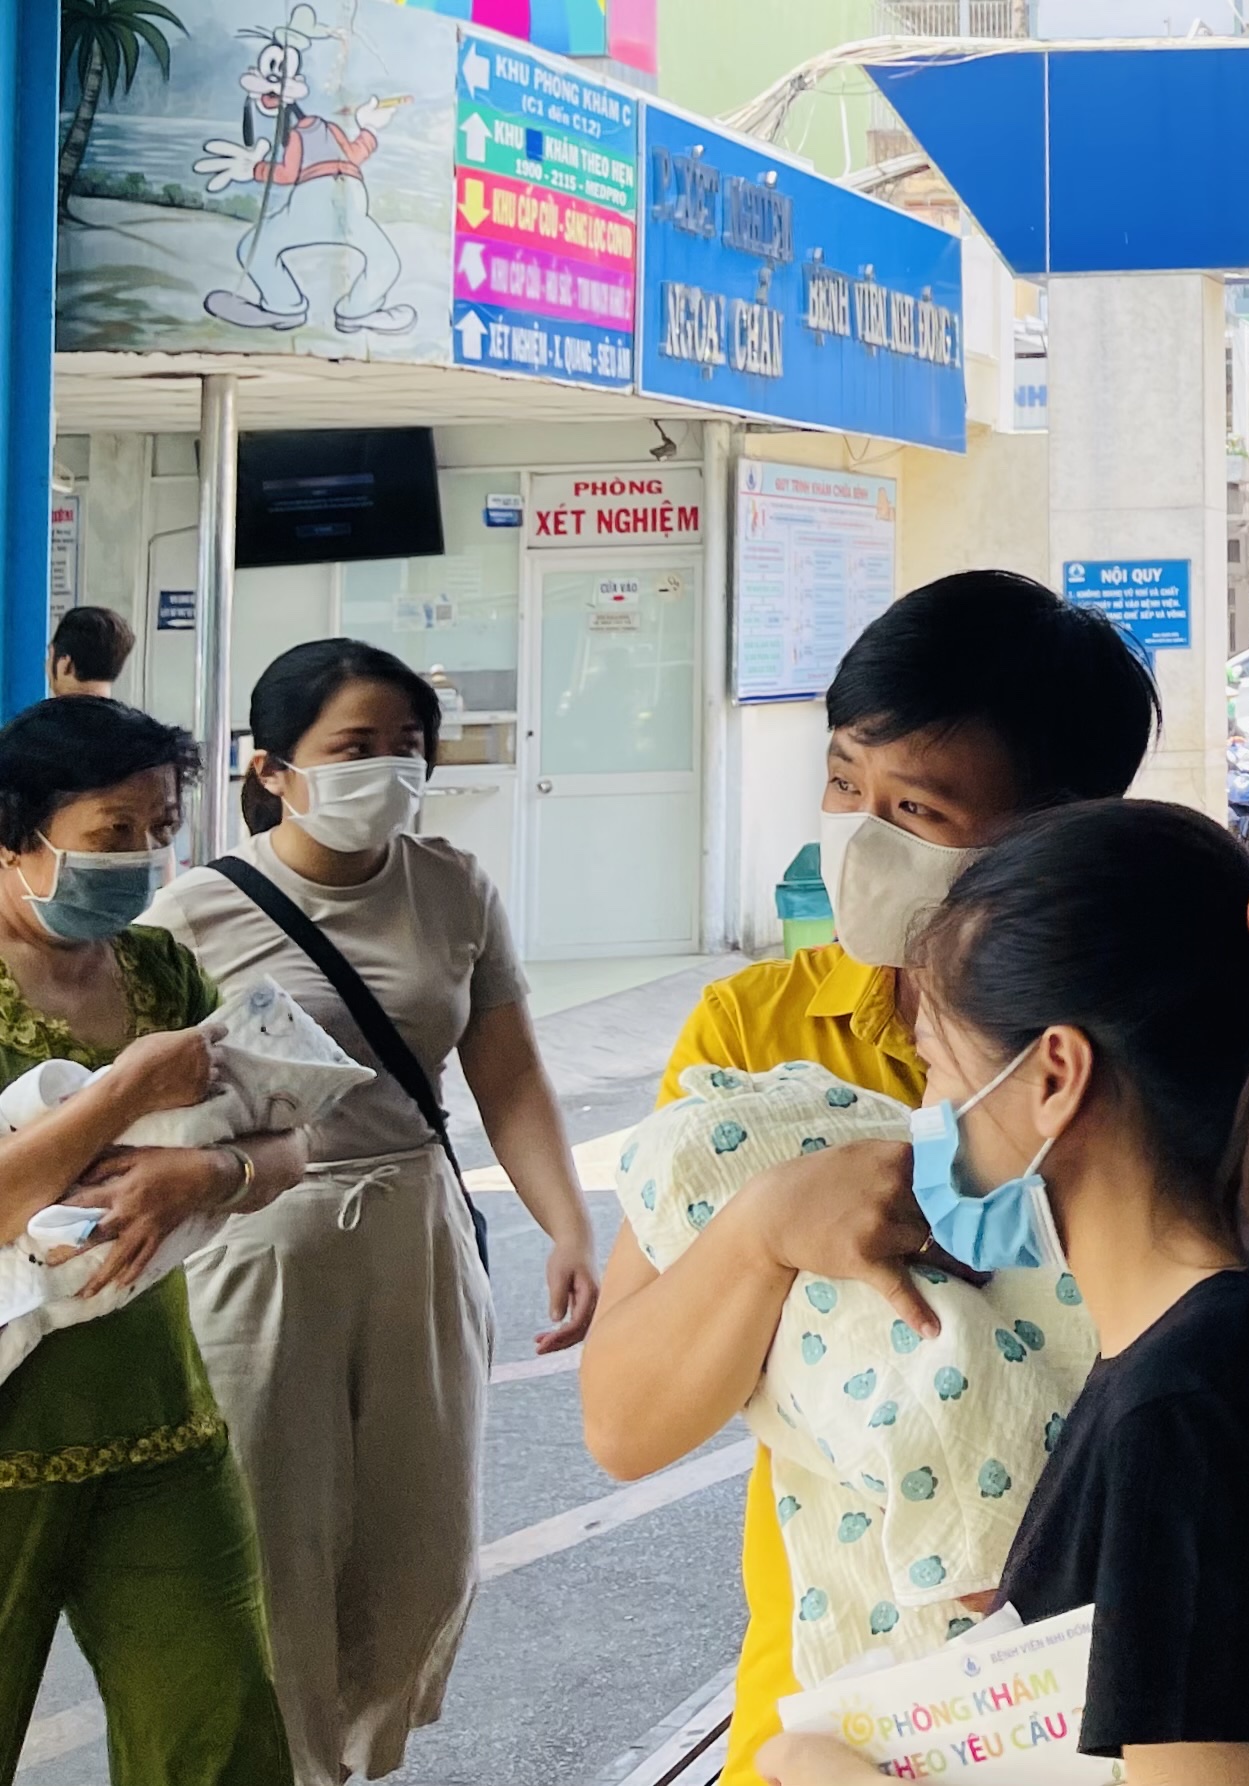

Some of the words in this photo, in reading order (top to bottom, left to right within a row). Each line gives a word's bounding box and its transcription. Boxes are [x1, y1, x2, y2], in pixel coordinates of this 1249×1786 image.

[495, 54, 530, 87] KHU
[583, 85, 620, 123] KHÁM
[622, 104, 632, 127] C
[494, 119, 524, 150] KHU
[581, 148, 610, 179] THEO
[515, 158, 543, 181] 1900
[550, 169, 577, 192] 2115
[573, 476, 663, 497] PHÒNG
[535, 502, 586, 537] XÉT
[597, 498, 700, 539] NGHIỆM
[1101, 565, 1128, 586] NỘI
[1132, 567, 1163, 585] QUY
[1066, 1621, 1093, 1641] ĐỒN
[876, 1695, 973, 1742] PHÒNG
[973, 1668, 1061, 1717] KHÁM
[951, 1732, 1006, 1766] YÊU
[1010, 1711, 1068, 1750] CẦU
